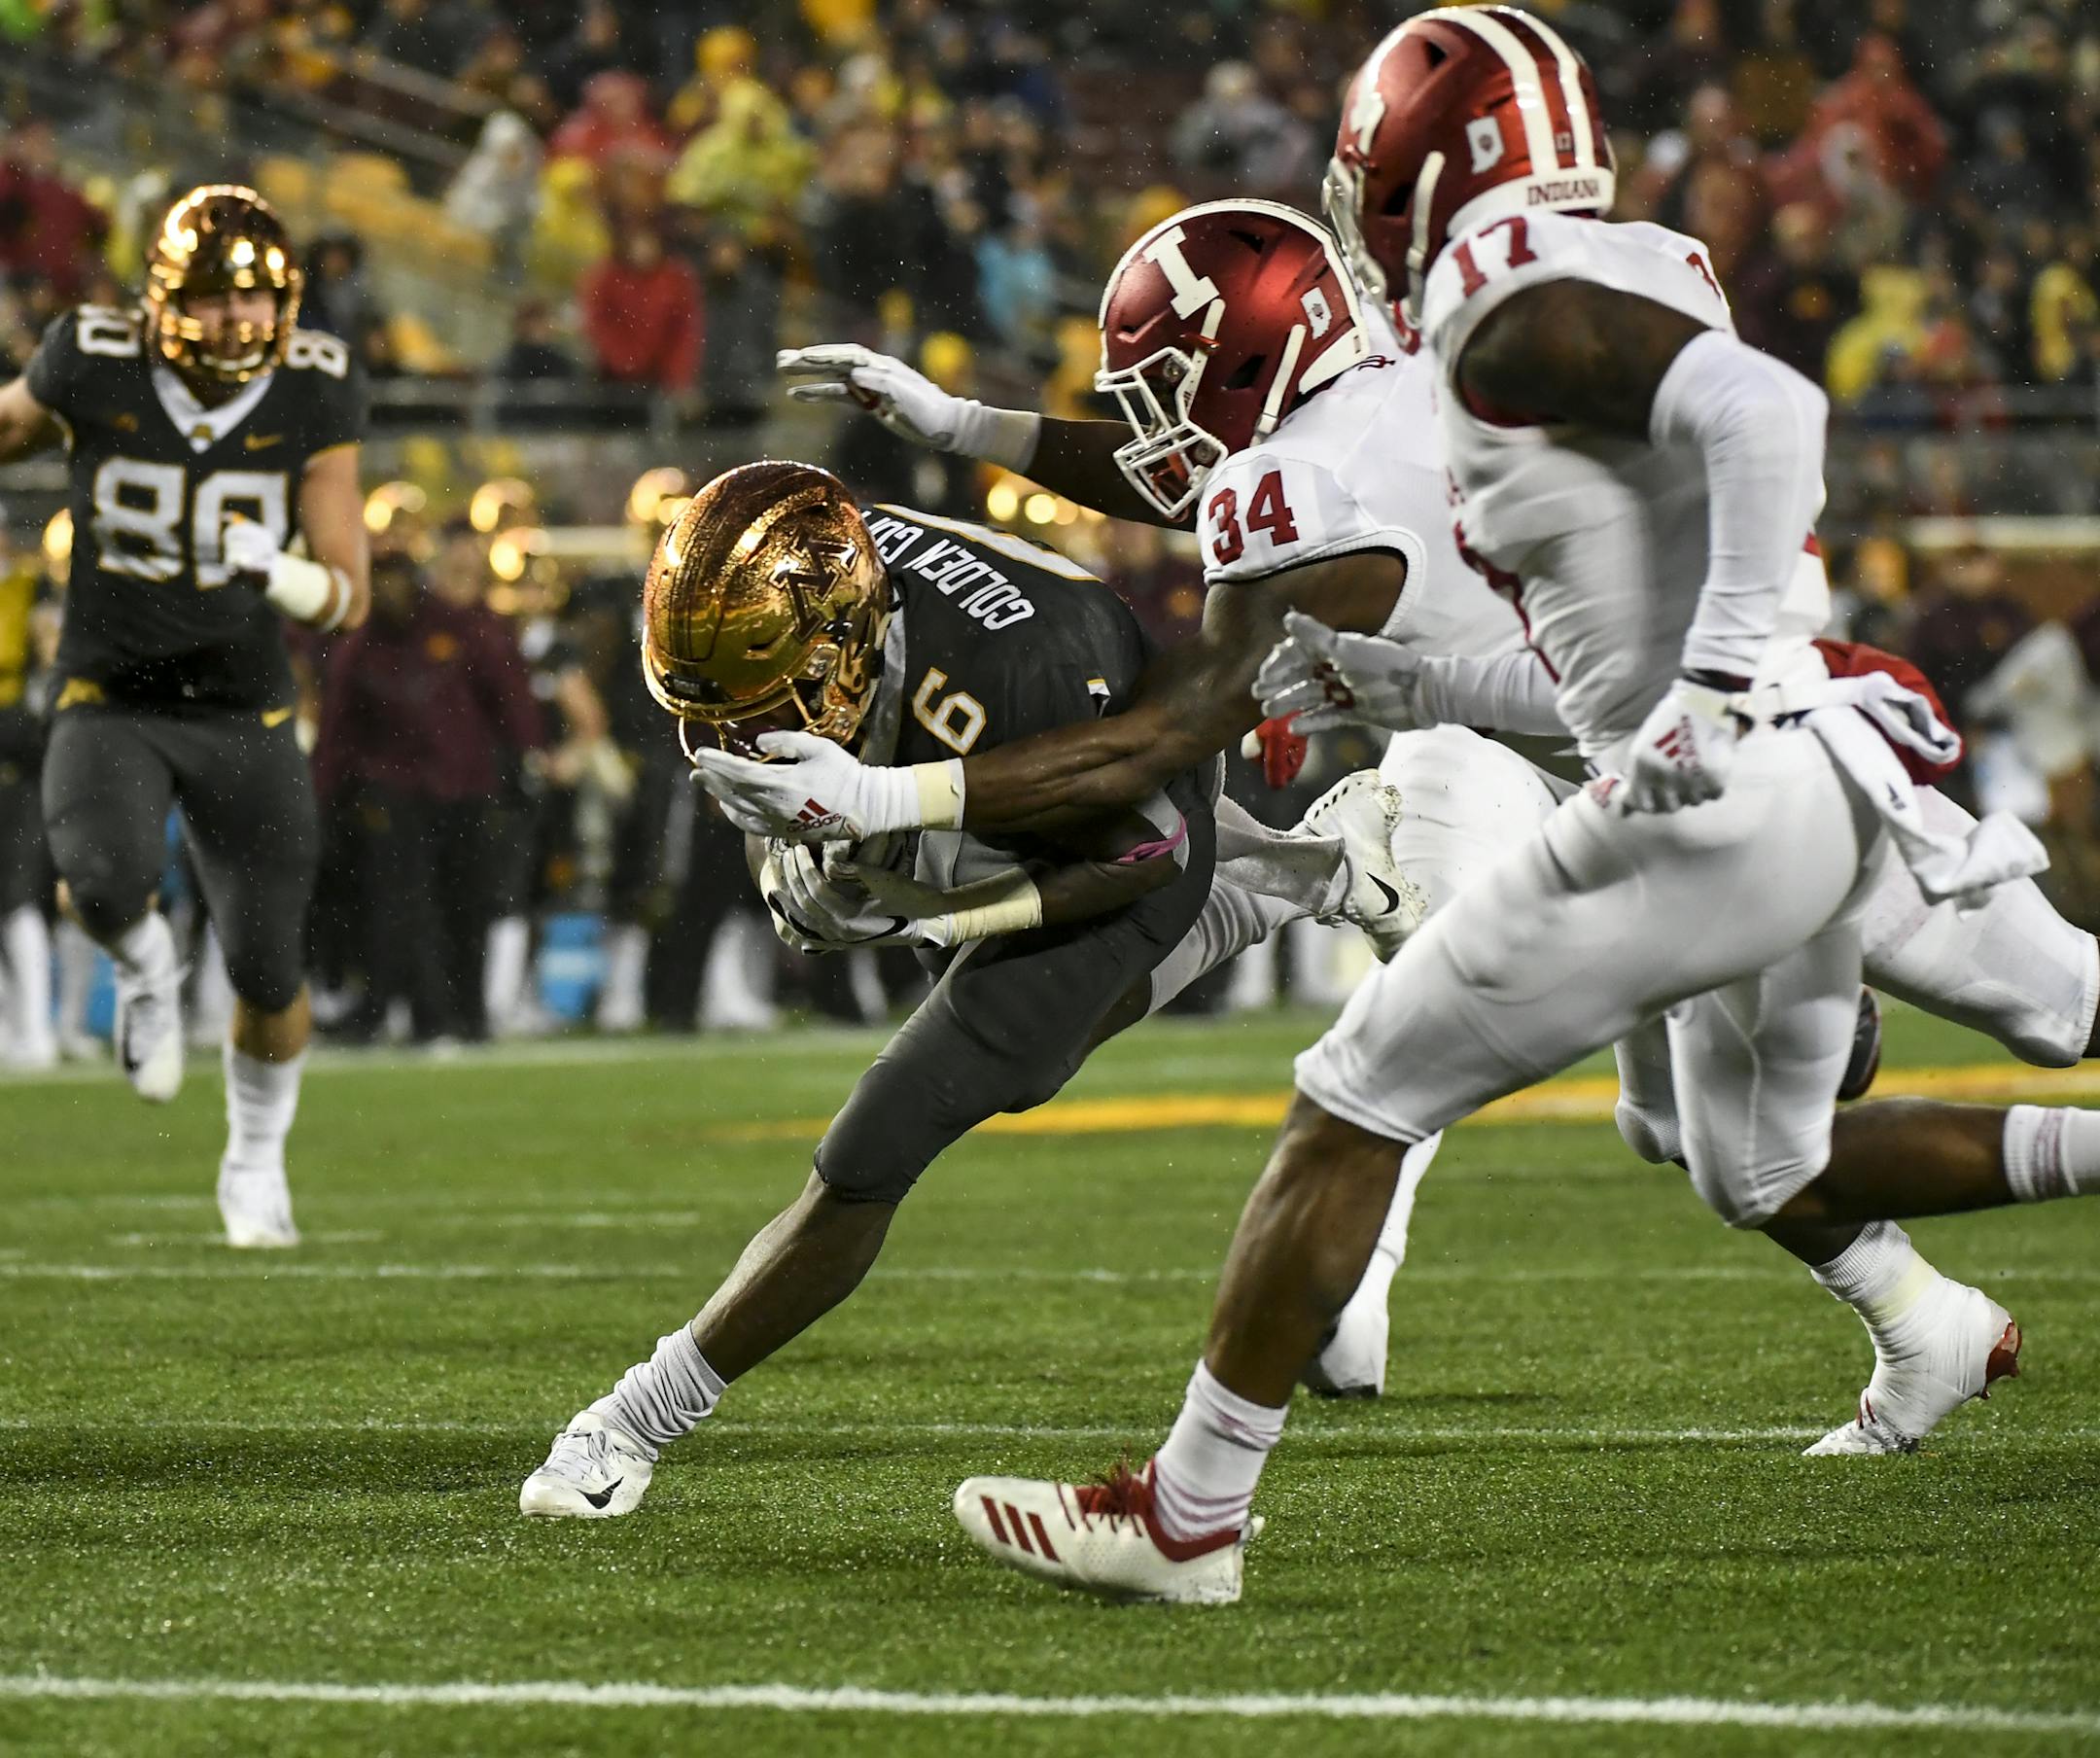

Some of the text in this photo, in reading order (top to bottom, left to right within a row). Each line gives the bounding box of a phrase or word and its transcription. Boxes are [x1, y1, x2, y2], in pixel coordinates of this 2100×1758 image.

[1452, 215, 1538, 298] 17
[92, 455, 289, 590] 80
[1208, 470, 1299, 566] 34
[902, 538, 1035, 630] GOLDEN
